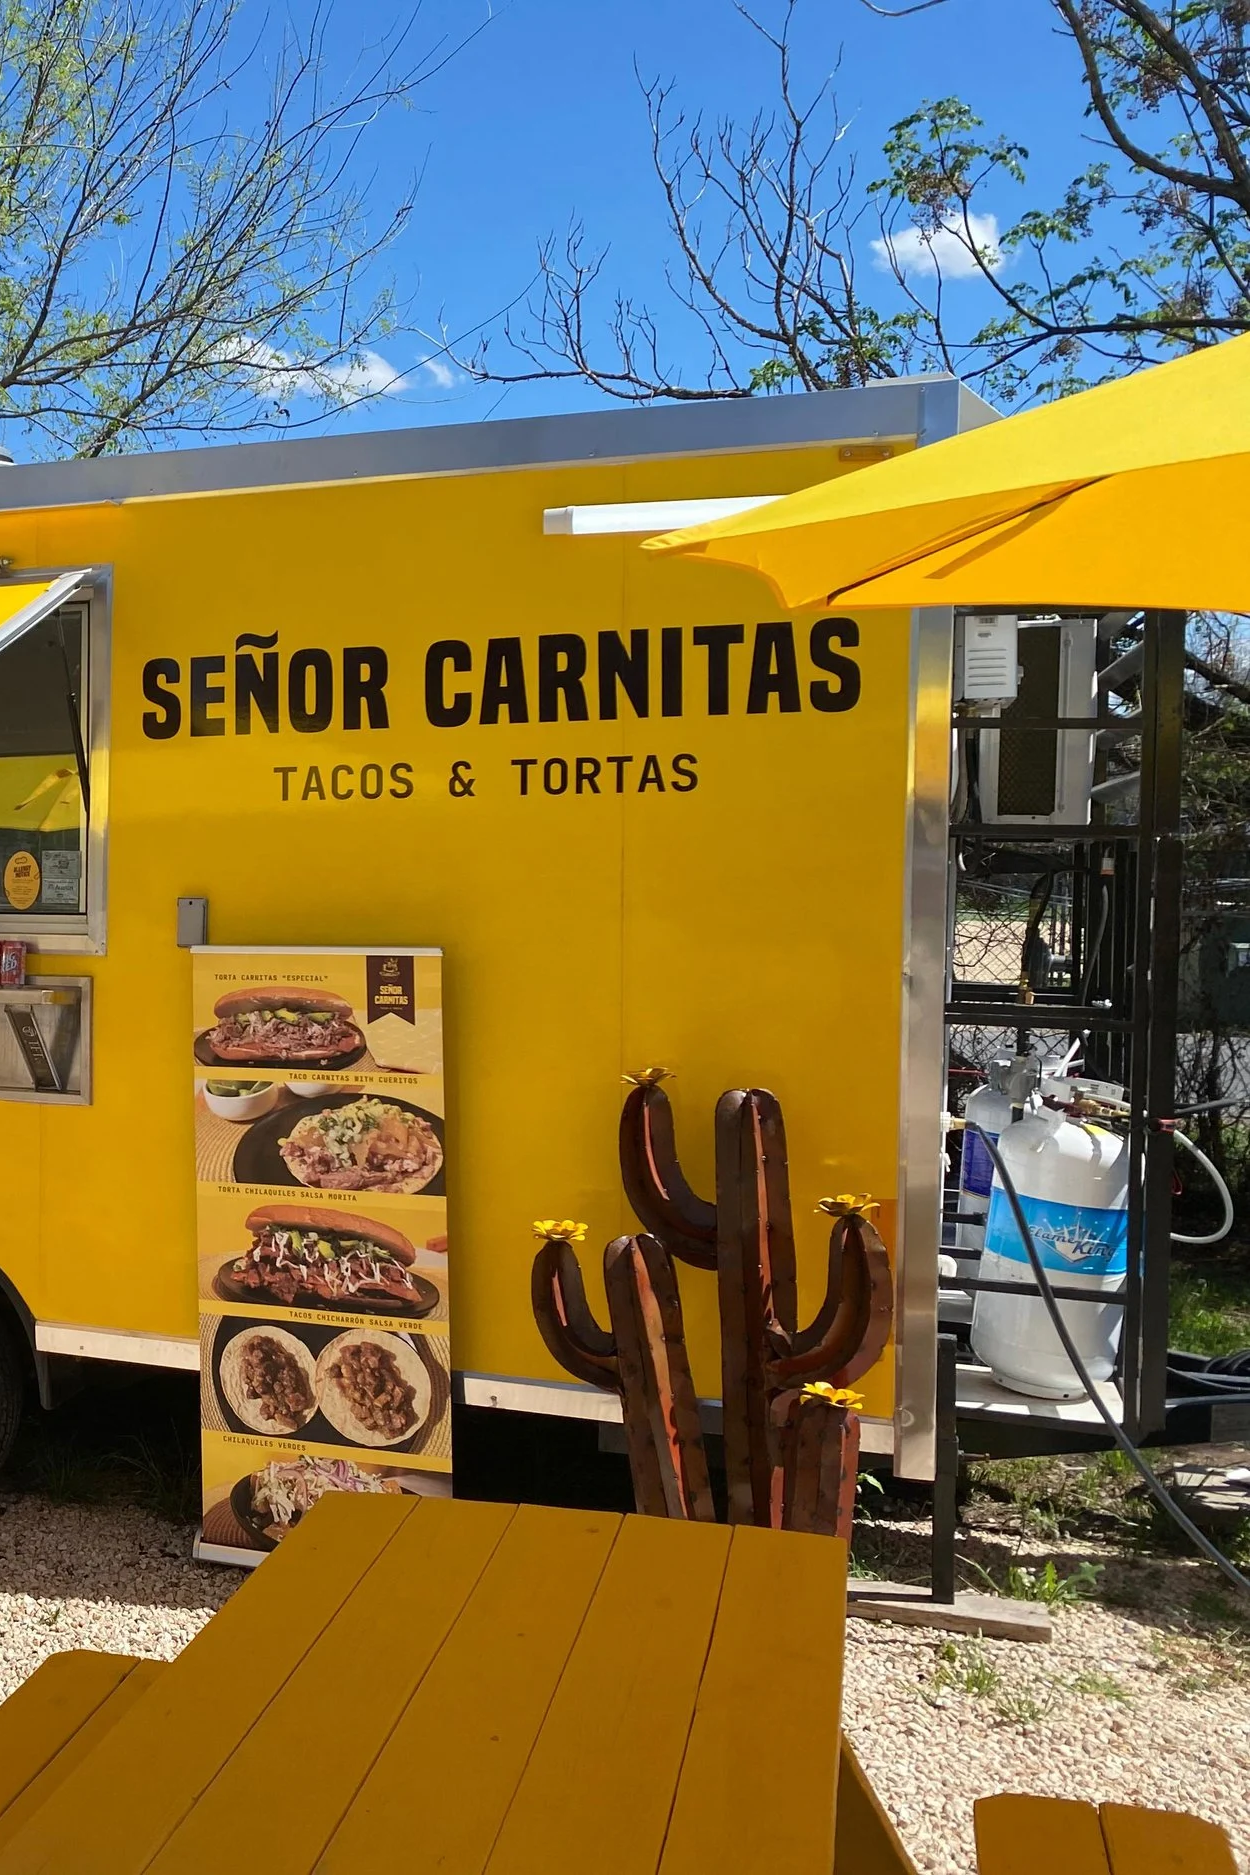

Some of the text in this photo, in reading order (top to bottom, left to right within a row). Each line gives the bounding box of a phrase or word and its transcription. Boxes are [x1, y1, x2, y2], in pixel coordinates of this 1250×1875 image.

[141, 616, 862, 740] SEÑOR CARNITAS
[273, 752, 700, 801] TACOS & TORTAS
[282, 974, 329, 982] "ESPECIAL"
[374, 995, 409, 1005] CARNITAS
[311, 1074, 350, 1082] CARNITAS
[378, 1076, 418, 1084] CUERITOS
[245, 1187, 296, 1197] CHILAQUILES
[300, 1191, 324, 1199] SALSA
[328, 1193, 357, 1201] MORITA
[1071, 1240, 1116, 1262] King
[289, 1311, 423, 1330] TACOS CHICHARRÓN SALSA VERDE
[223, 1435, 306, 1452] CHILAQUILES VERDES
